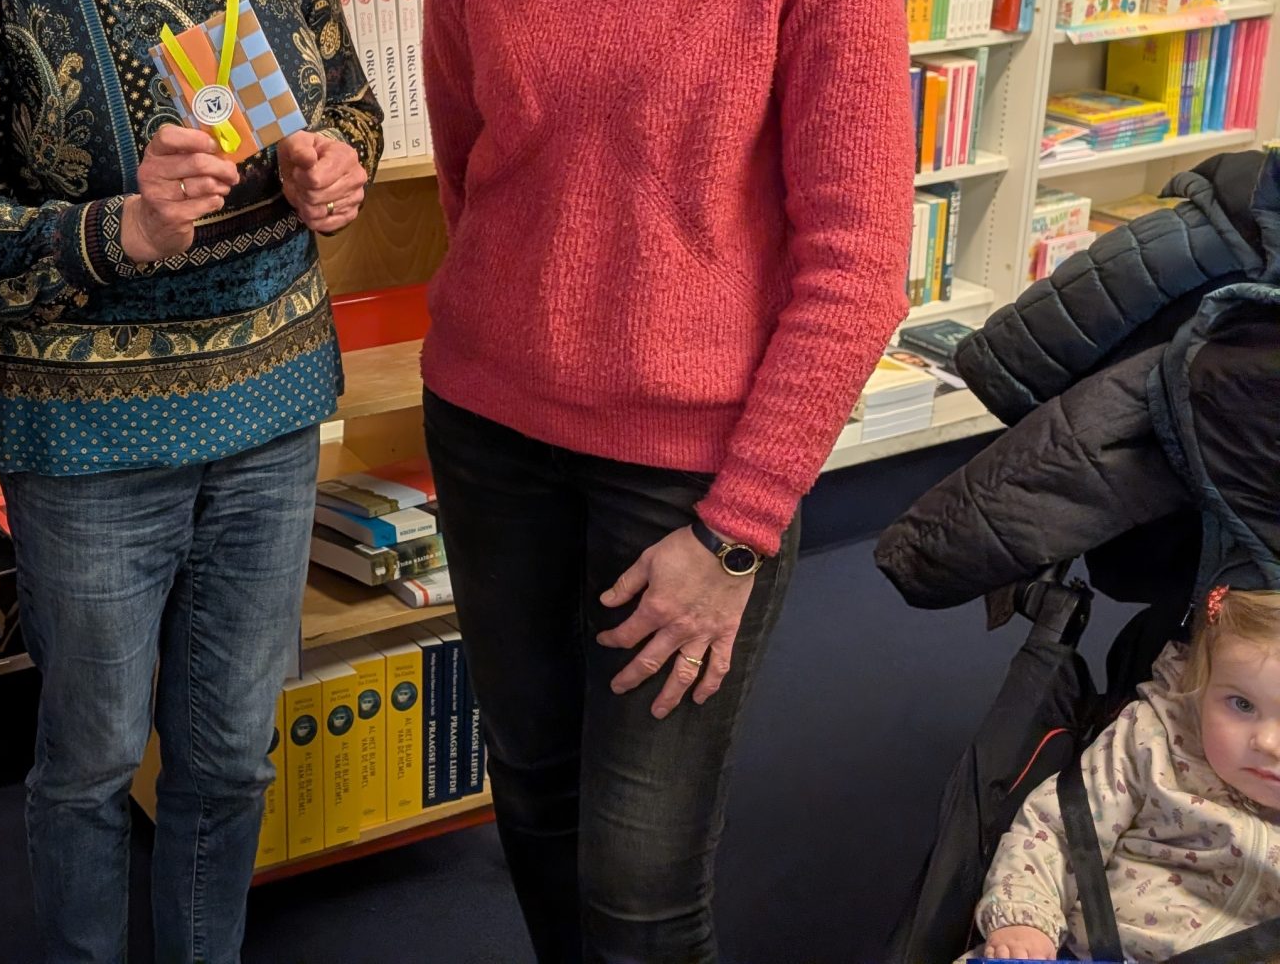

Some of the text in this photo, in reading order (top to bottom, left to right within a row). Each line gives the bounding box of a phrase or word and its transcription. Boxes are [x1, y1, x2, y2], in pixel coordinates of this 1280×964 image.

[385, 46, 399, 119] ORGANISCH
[406, 44, 418, 117] ORGANISCH
[428, 765, 436, 799] LIEFDE
[449, 716, 458, 794] PRAAGSE LIEFDE
[471, 709, 480, 787] PRAAGSE LIEFDE
